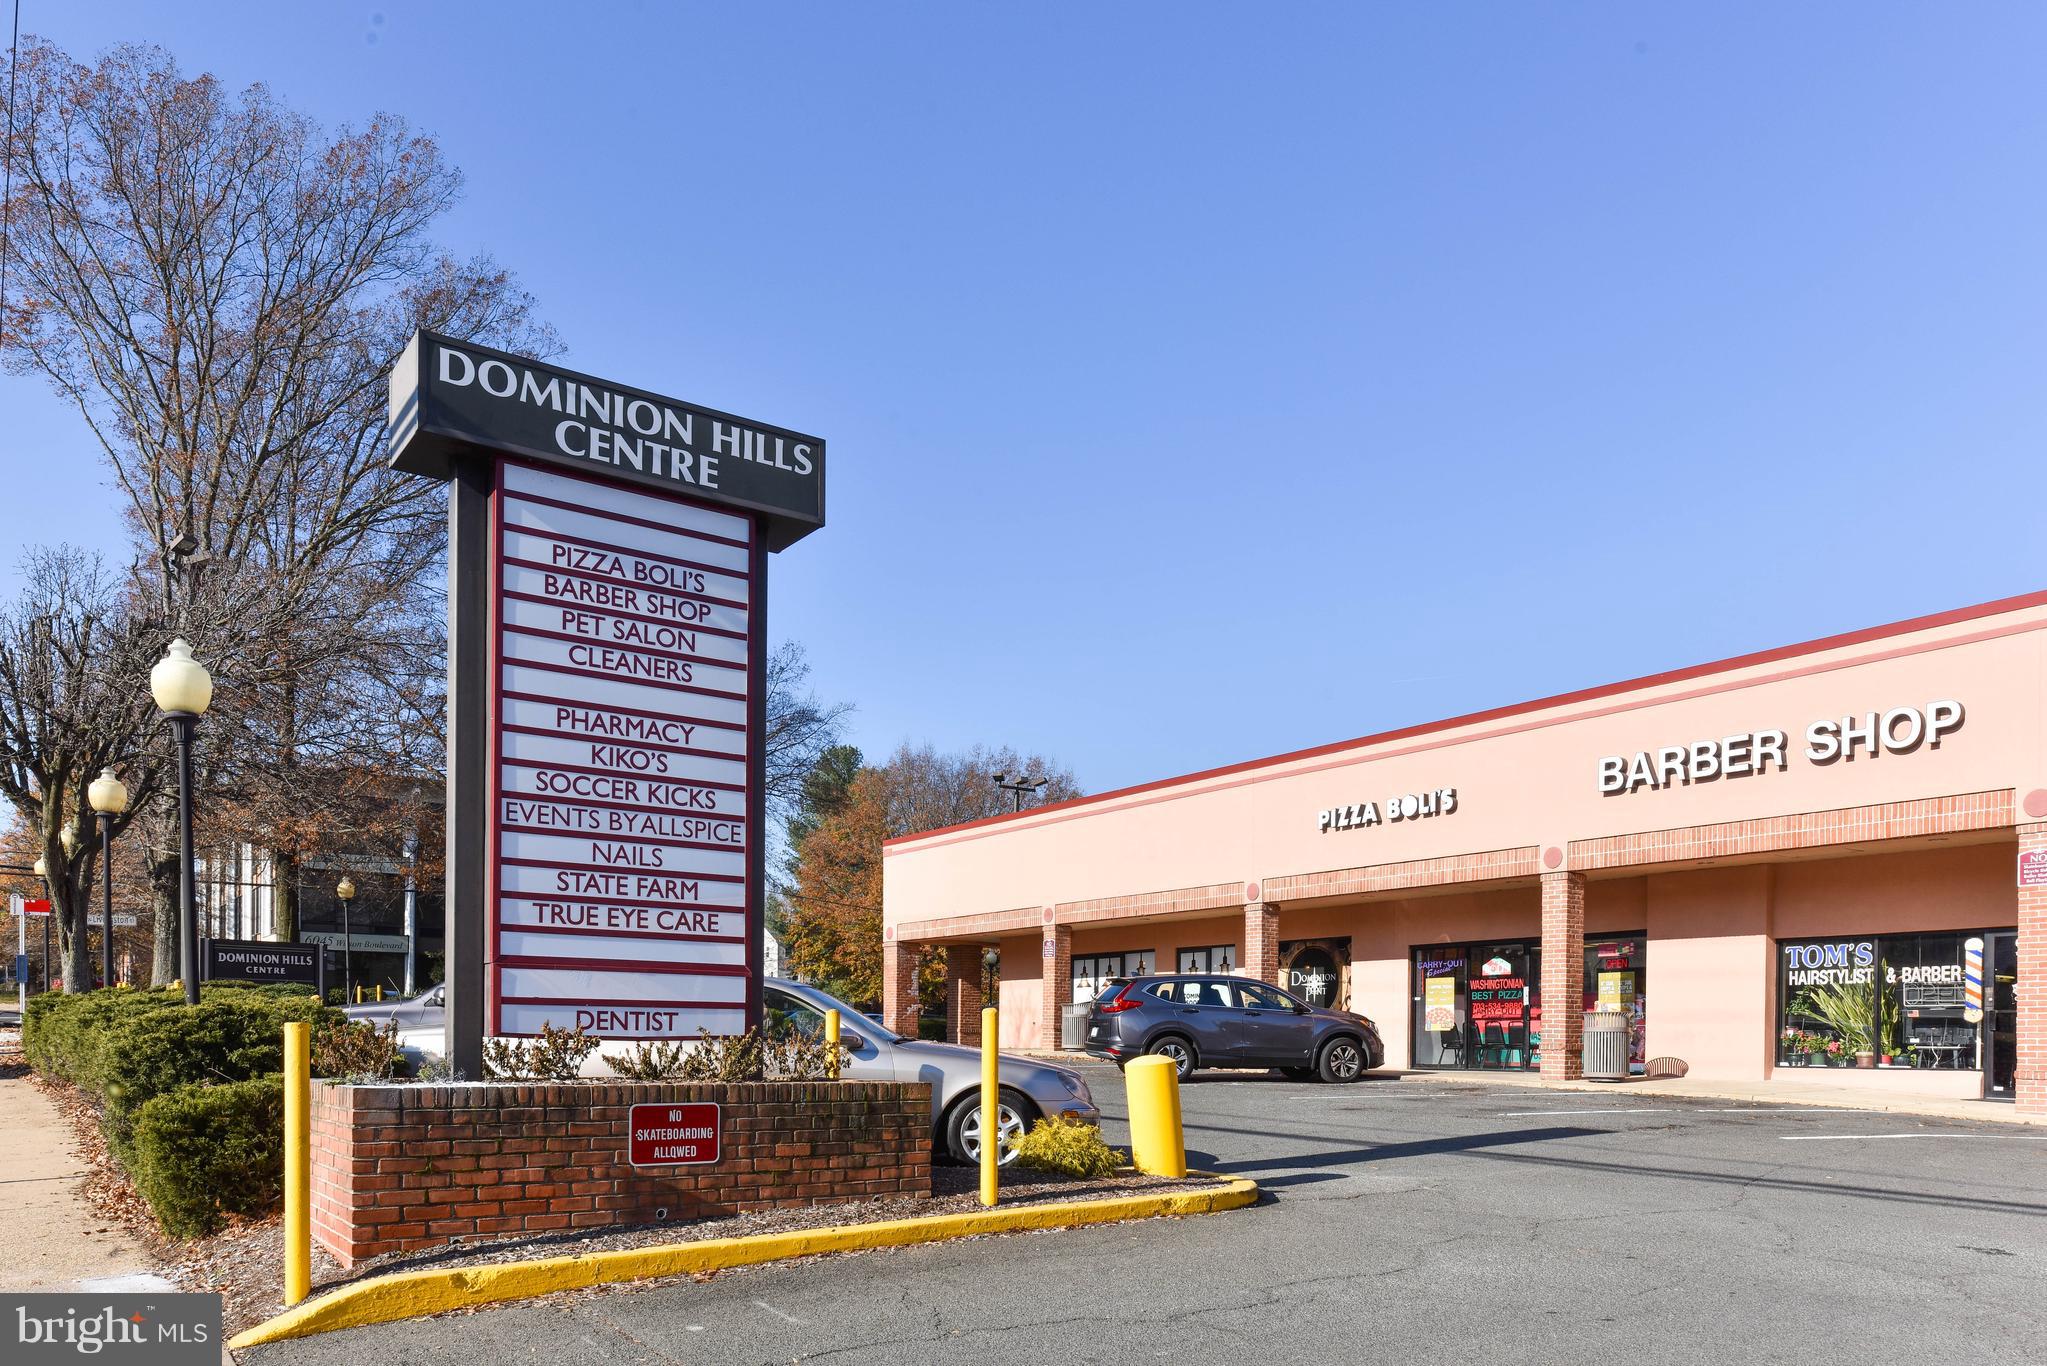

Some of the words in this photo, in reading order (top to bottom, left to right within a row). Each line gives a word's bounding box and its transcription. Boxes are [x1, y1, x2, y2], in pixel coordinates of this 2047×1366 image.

[438, 346, 692, 445] DOMINION
[712, 421, 813, 476] HILLS
[554, 419, 719, 489] CENTRE
[552, 543, 626, 578] PIZZA
[634, 560, 705, 593] BOLI'S
[544, 573, 640, 612] BARBER
[647, 594, 711, 623] SHOP
[562, 610, 606, 635] PET
[613, 619, 696, 652] SALON
[568, 645, 693, 683] CLEANERS
[556, 708, 695, 745] PHARMACY
[591, 745, 668, 773] KIKO'S
[1598, 728, 1786, 796] BARBER
[1804, 699, 1964, 765] SHOP
[536, 771, 638, 802] SOCCER
[648, 784, 717, 810] KICKS
[505, 802, 600, 829] EVENTS
[1318, 802, 1380, 832] PIZZA
[1386, 788, 1456, 821] BOLI'S
[592, 843, 663, 867] NAILS
[2030, 853, 2047, 863] NO
[557, 871, 628, 896] STATE
[637, 877, 698, 900] FARM
[532, 902, 598, 926] TRUE
[607, 907, 648, 929] EYE
[656, 910, 719, 933] CARE
[305, 935, 334, 947] 6045
[364, 940, 404, 950] Boulevard
[1785, 943, 1873, 968] TOM'S
[218, 952, 279, 964] DOMINION
[282, 955, 313, 966] HILLS
[246, 966, 286, 975] CENTRE
[1417, 959, 1464, 969] CARRY-OUT
[1470, 979, 1524, 990] WASHINGTONIAN
[1788, 968, 1873, 986] HAIRSTYLIST
[1886, 968, 1897, 984] &
[1901, 965, 1961, 984] BARBER
[1472, 991, 1493, 1000] BEST
[1498, 990, 1522, 999] PIZZA
[576, 1010, 679, 1031] DENTIST
[669, 1109, 682, 1122] NO
[637, 1128, 713, 1141] SKATEBOARDING
[654, 1146, 697, 1158] ALLOWED
